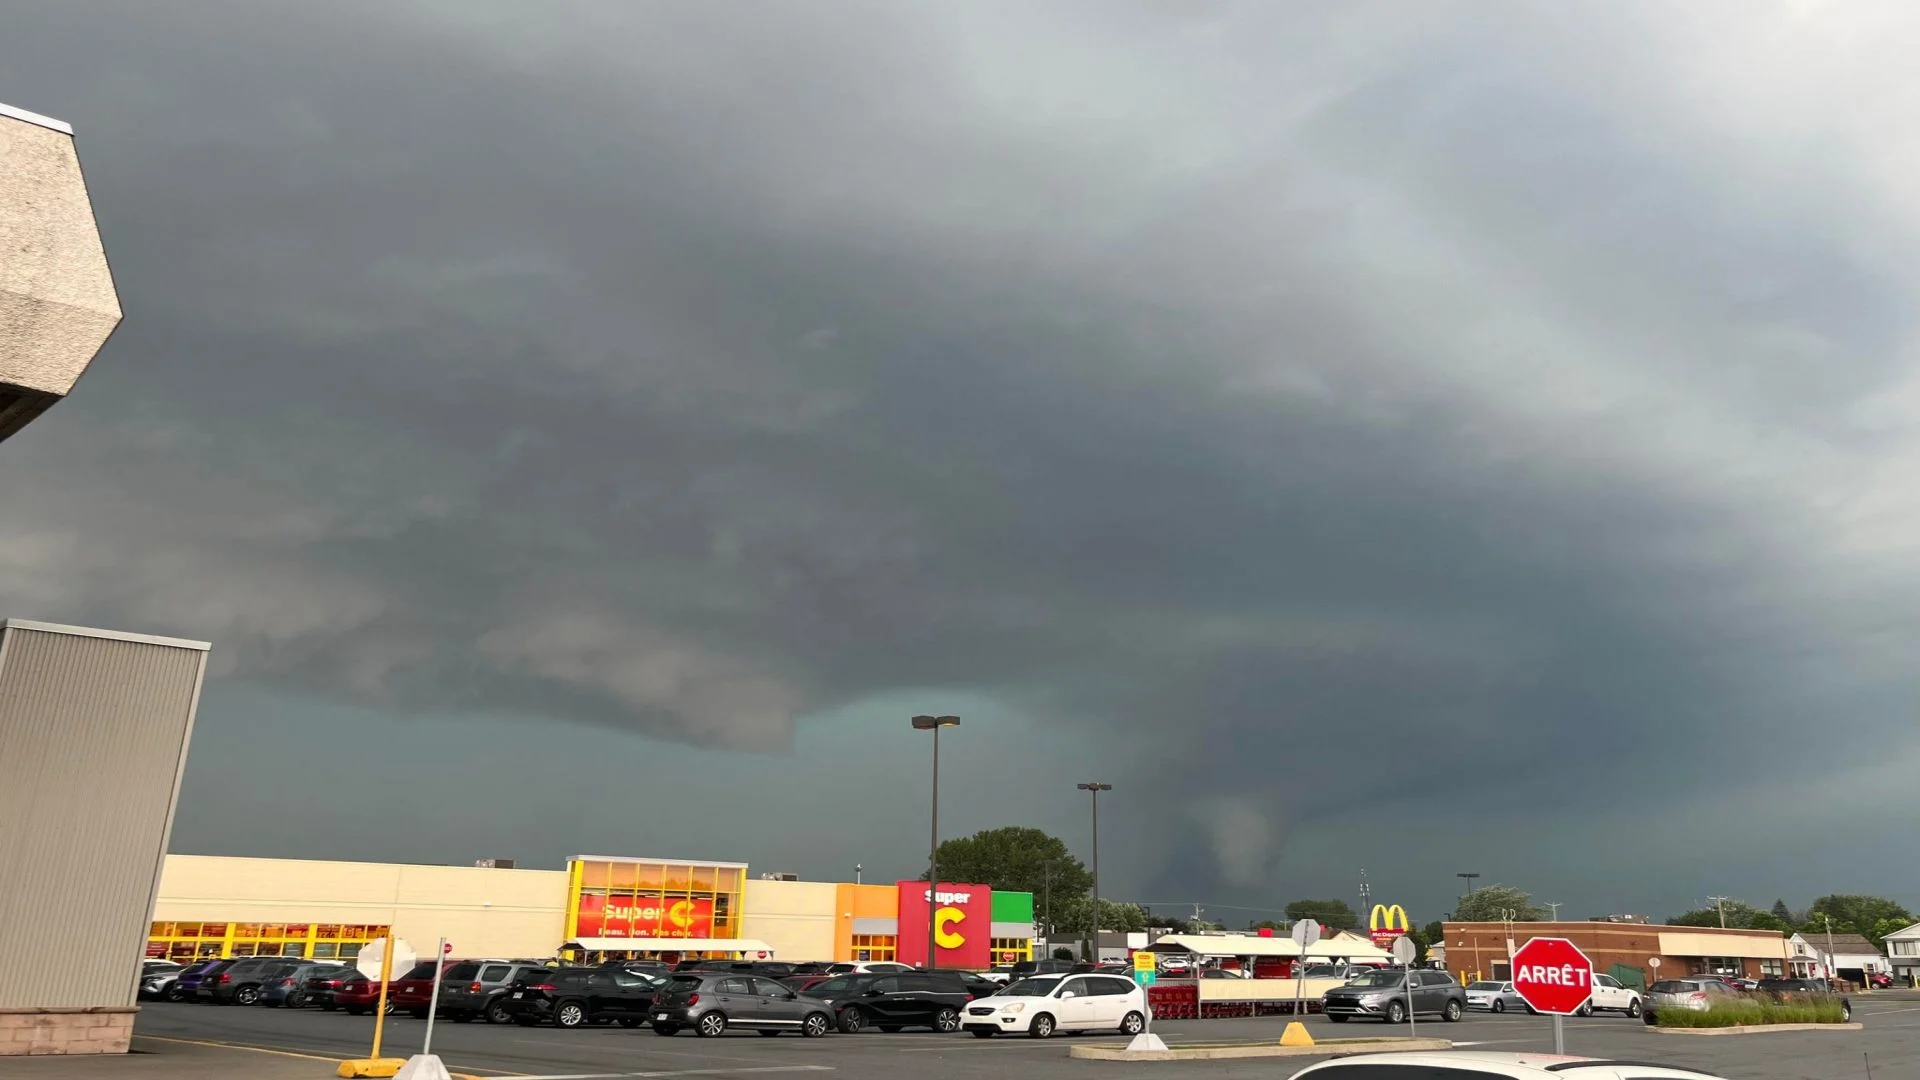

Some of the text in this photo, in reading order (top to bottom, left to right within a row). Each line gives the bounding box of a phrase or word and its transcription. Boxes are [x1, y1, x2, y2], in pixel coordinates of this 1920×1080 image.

[924, 889, 971, 905] Super
[602, 900, 696, 928] Super C
[928, 906, 967, 949] C
[1517, 963, 1589, 987] ARRÊT
